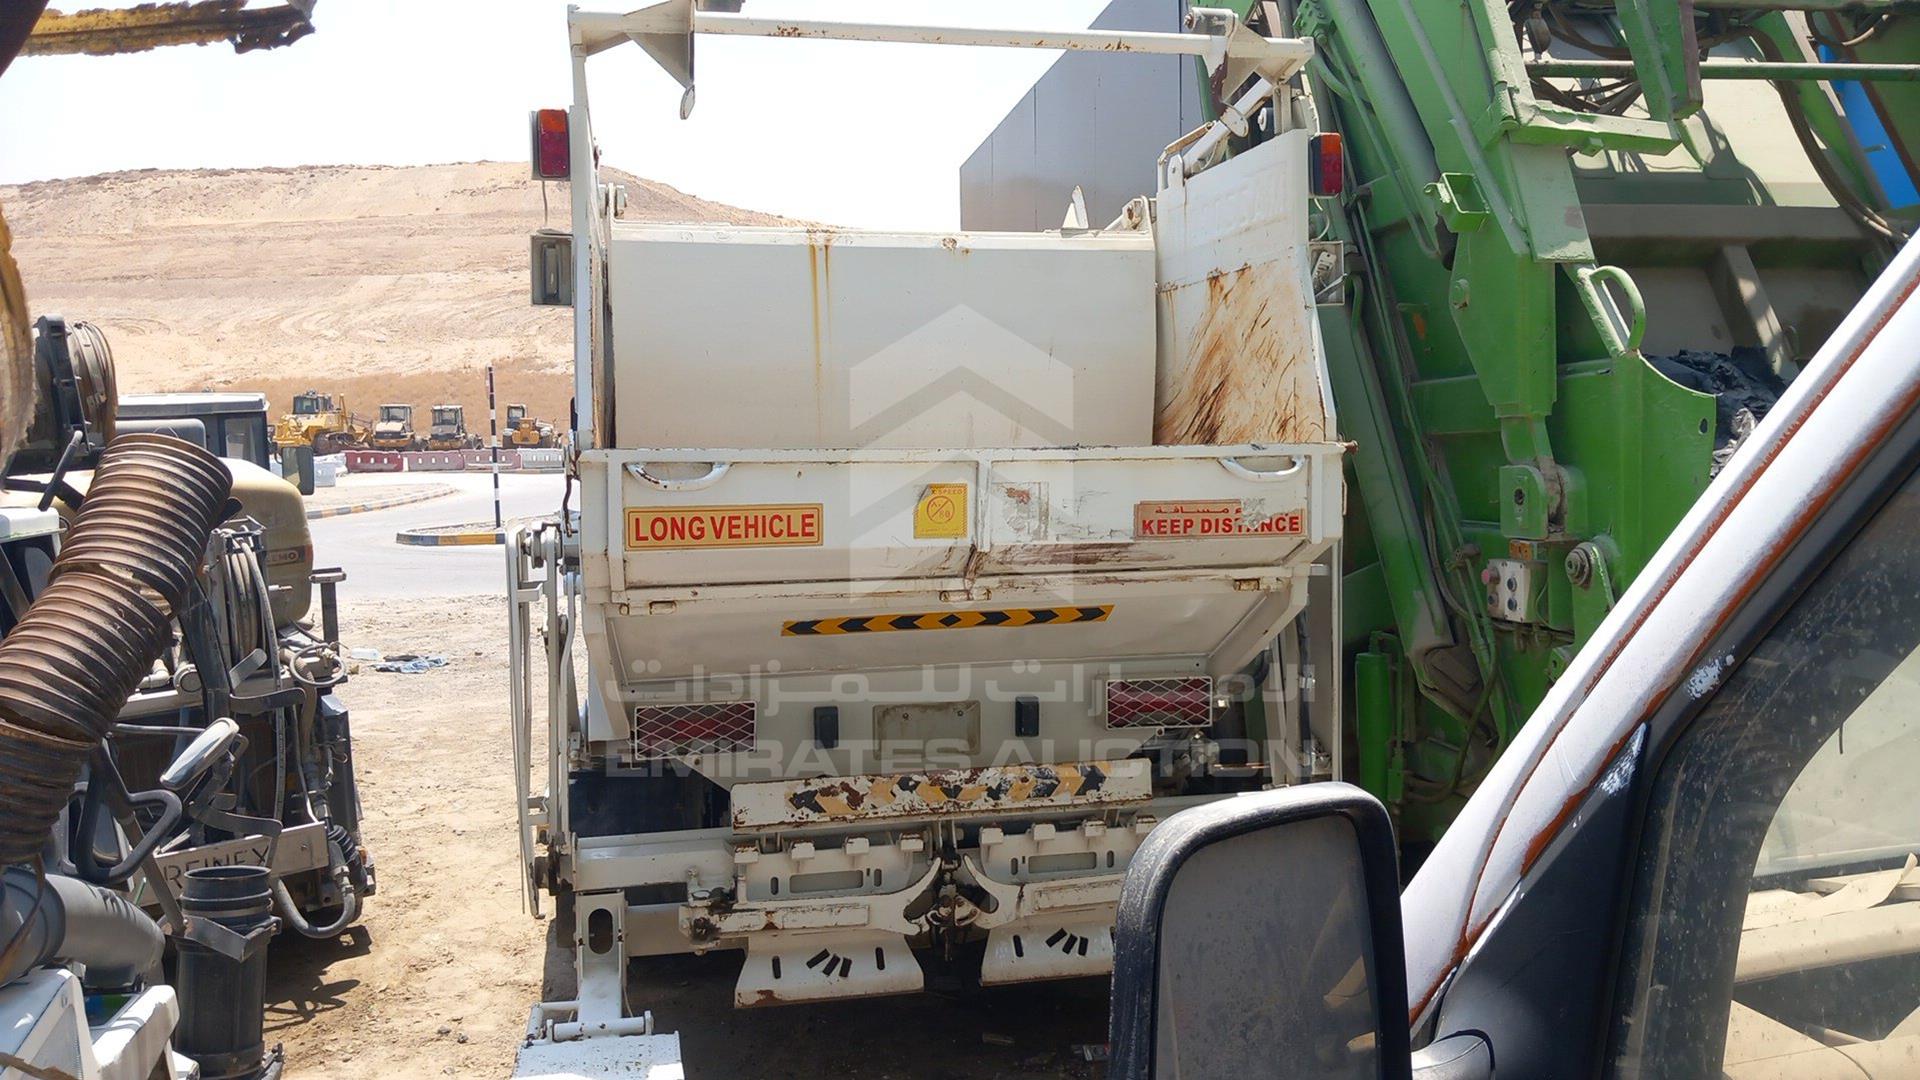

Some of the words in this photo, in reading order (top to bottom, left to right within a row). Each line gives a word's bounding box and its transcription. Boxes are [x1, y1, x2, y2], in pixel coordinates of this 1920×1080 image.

[635, 515, 705, 542] LONG
[710, 513, 815, 540] VEHICLE
[1142, 518, 1194, 535] KEEP
